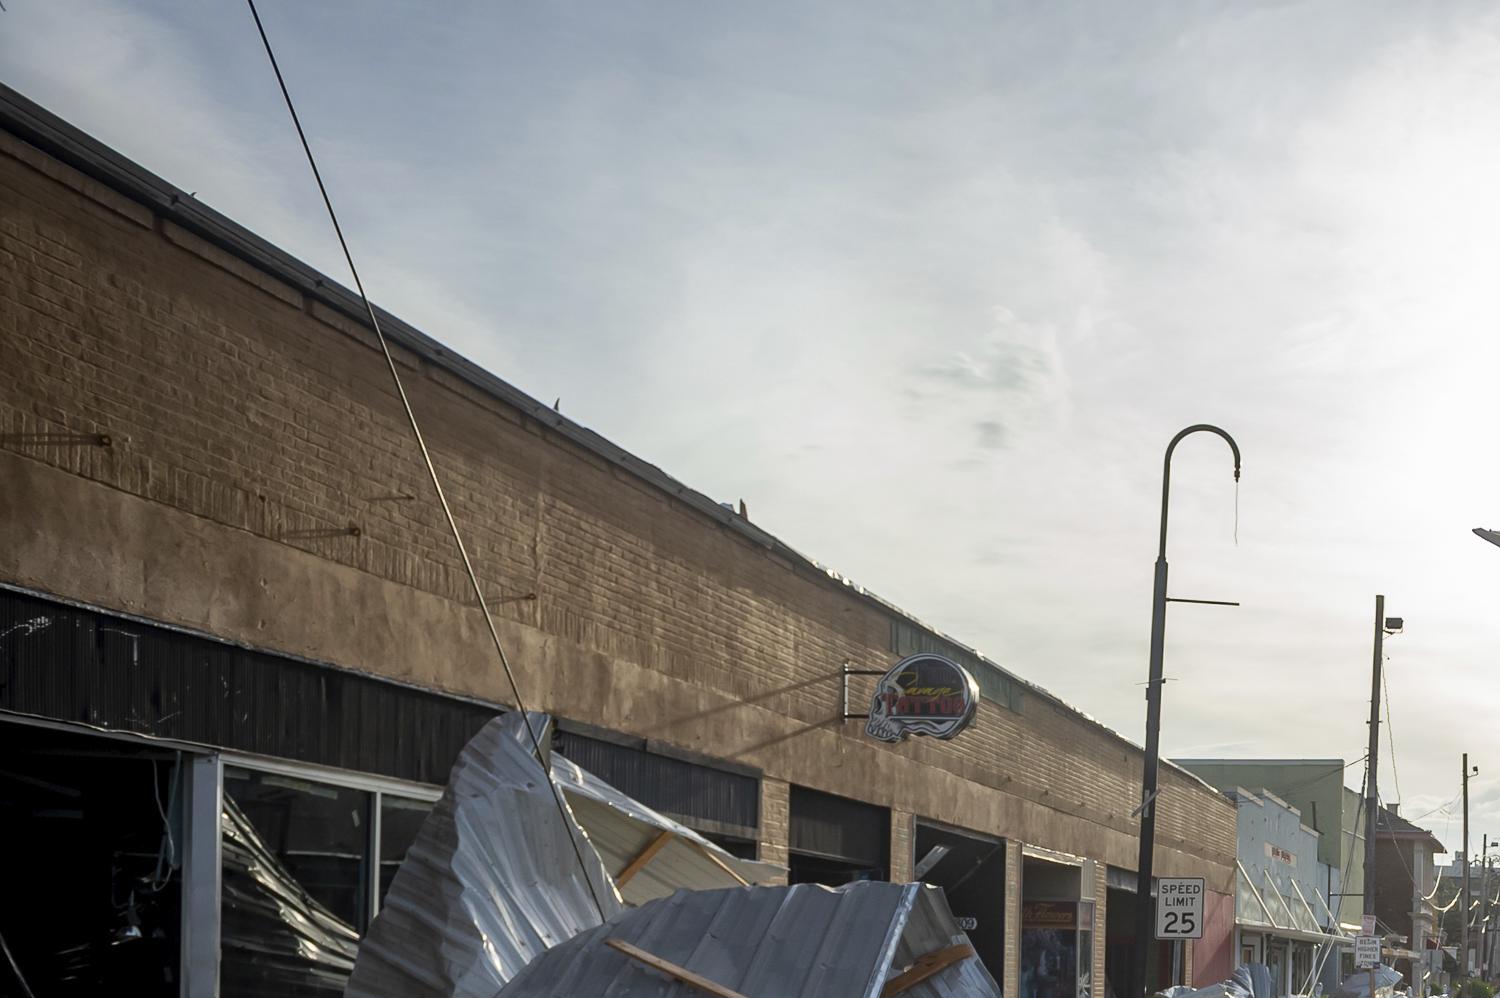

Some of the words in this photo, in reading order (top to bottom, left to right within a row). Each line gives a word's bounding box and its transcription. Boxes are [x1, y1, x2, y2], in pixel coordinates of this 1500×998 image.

[1161, 884, 1200, 894] SPEED
[1165, 897, 1195, 907] LIMIT
[1164, 911, 1195, 934] 25
